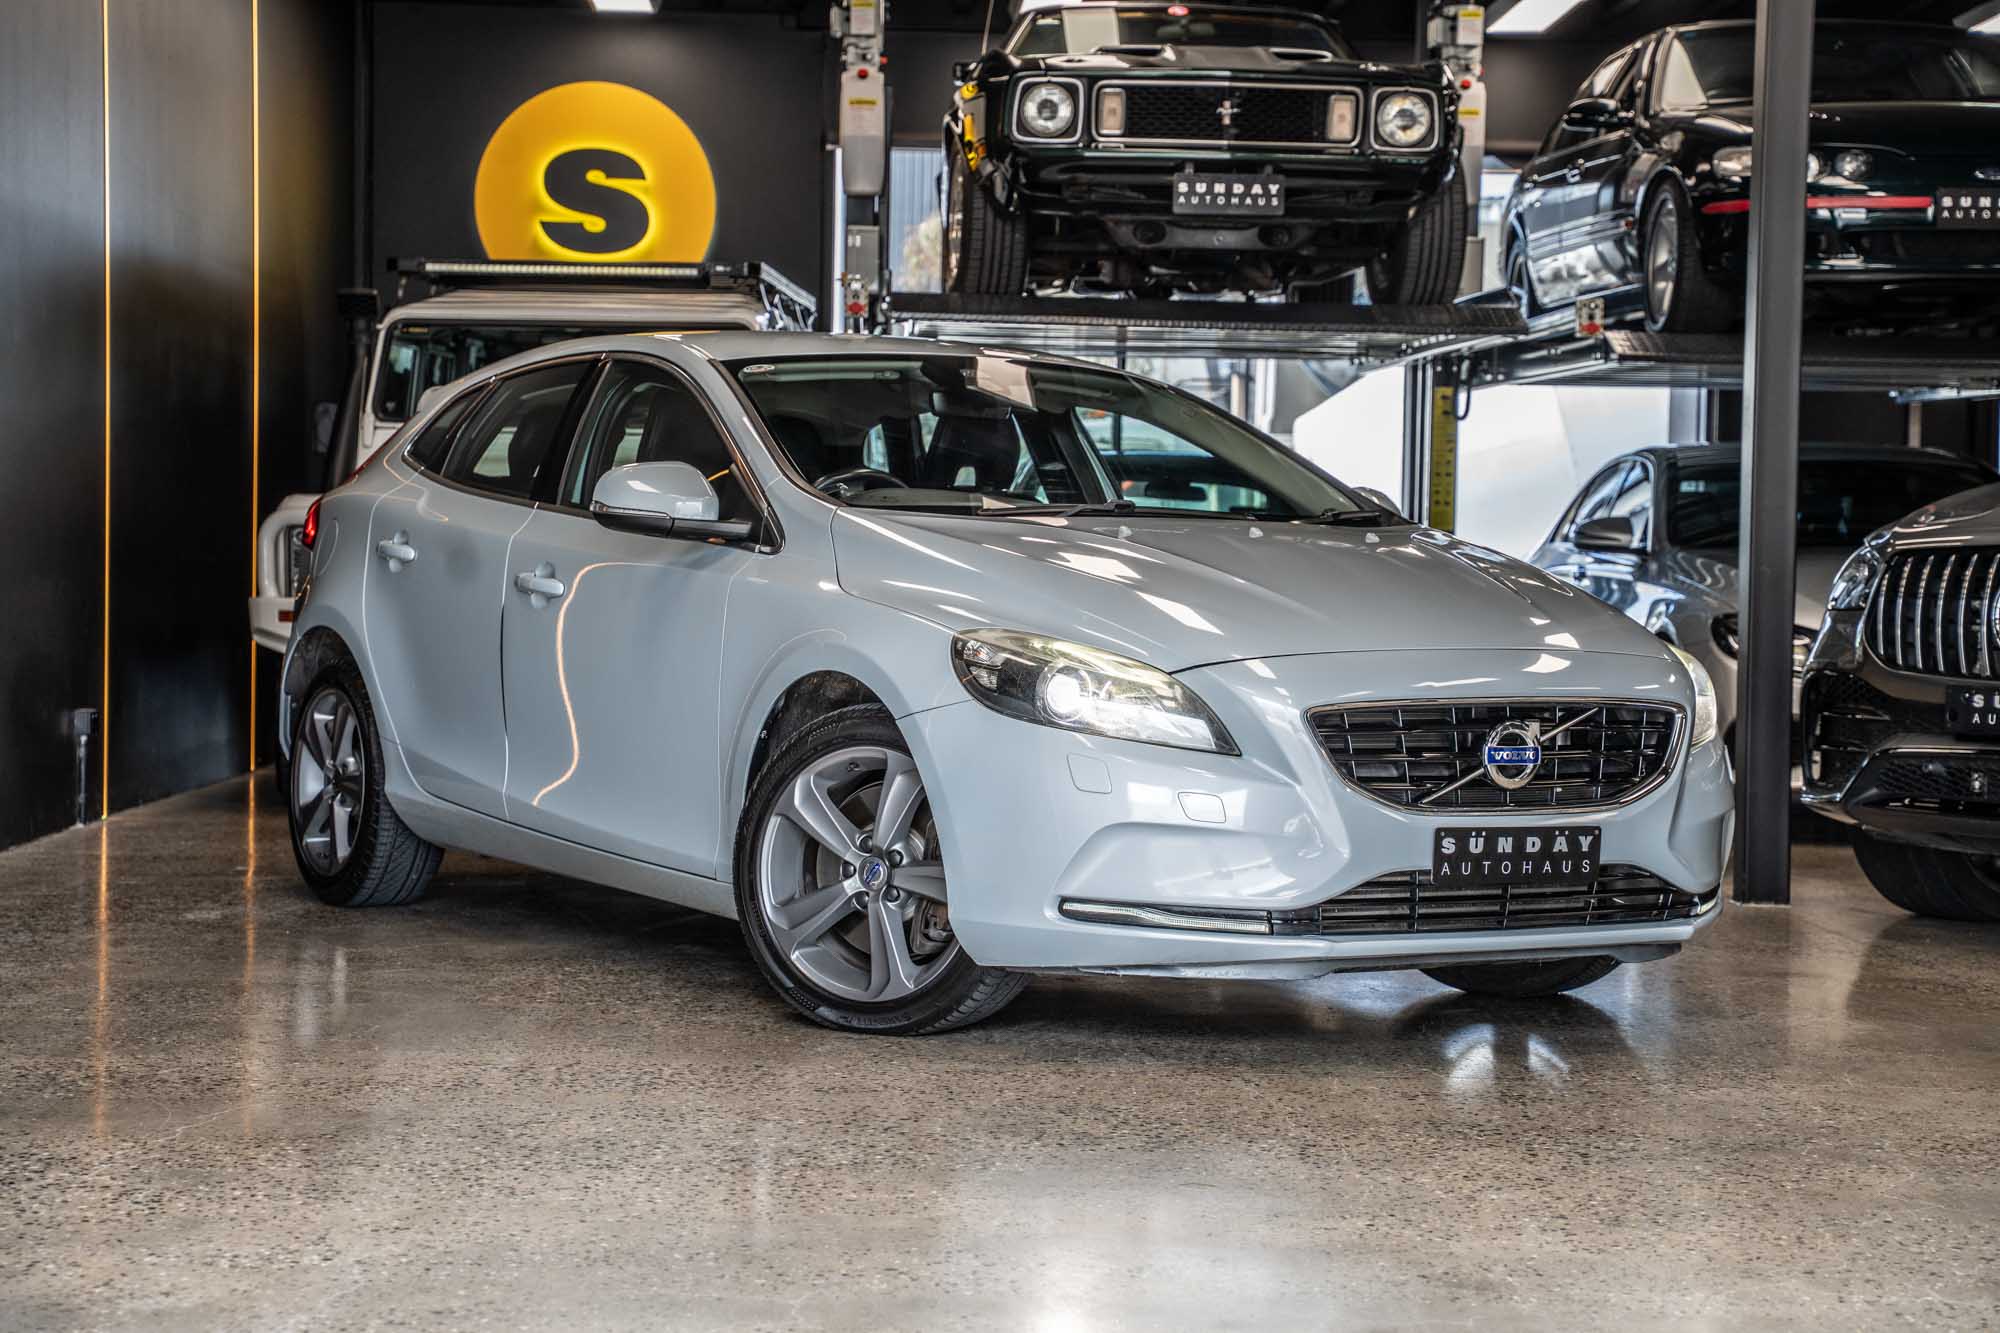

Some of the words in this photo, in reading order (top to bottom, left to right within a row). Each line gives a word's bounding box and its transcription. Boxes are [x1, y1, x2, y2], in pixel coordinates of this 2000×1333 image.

[540, 148, 650, 254] S
[1178, 195, 1279, 206] AUTOHAUS
[1941, 196, 2000, 208] SUN
[1490, 751, 1537, 761] VOLVO
[1440, 830, 1594, 854] SÜNDÄY
[1440, 860, 1591, 876] AUTOHAUS
